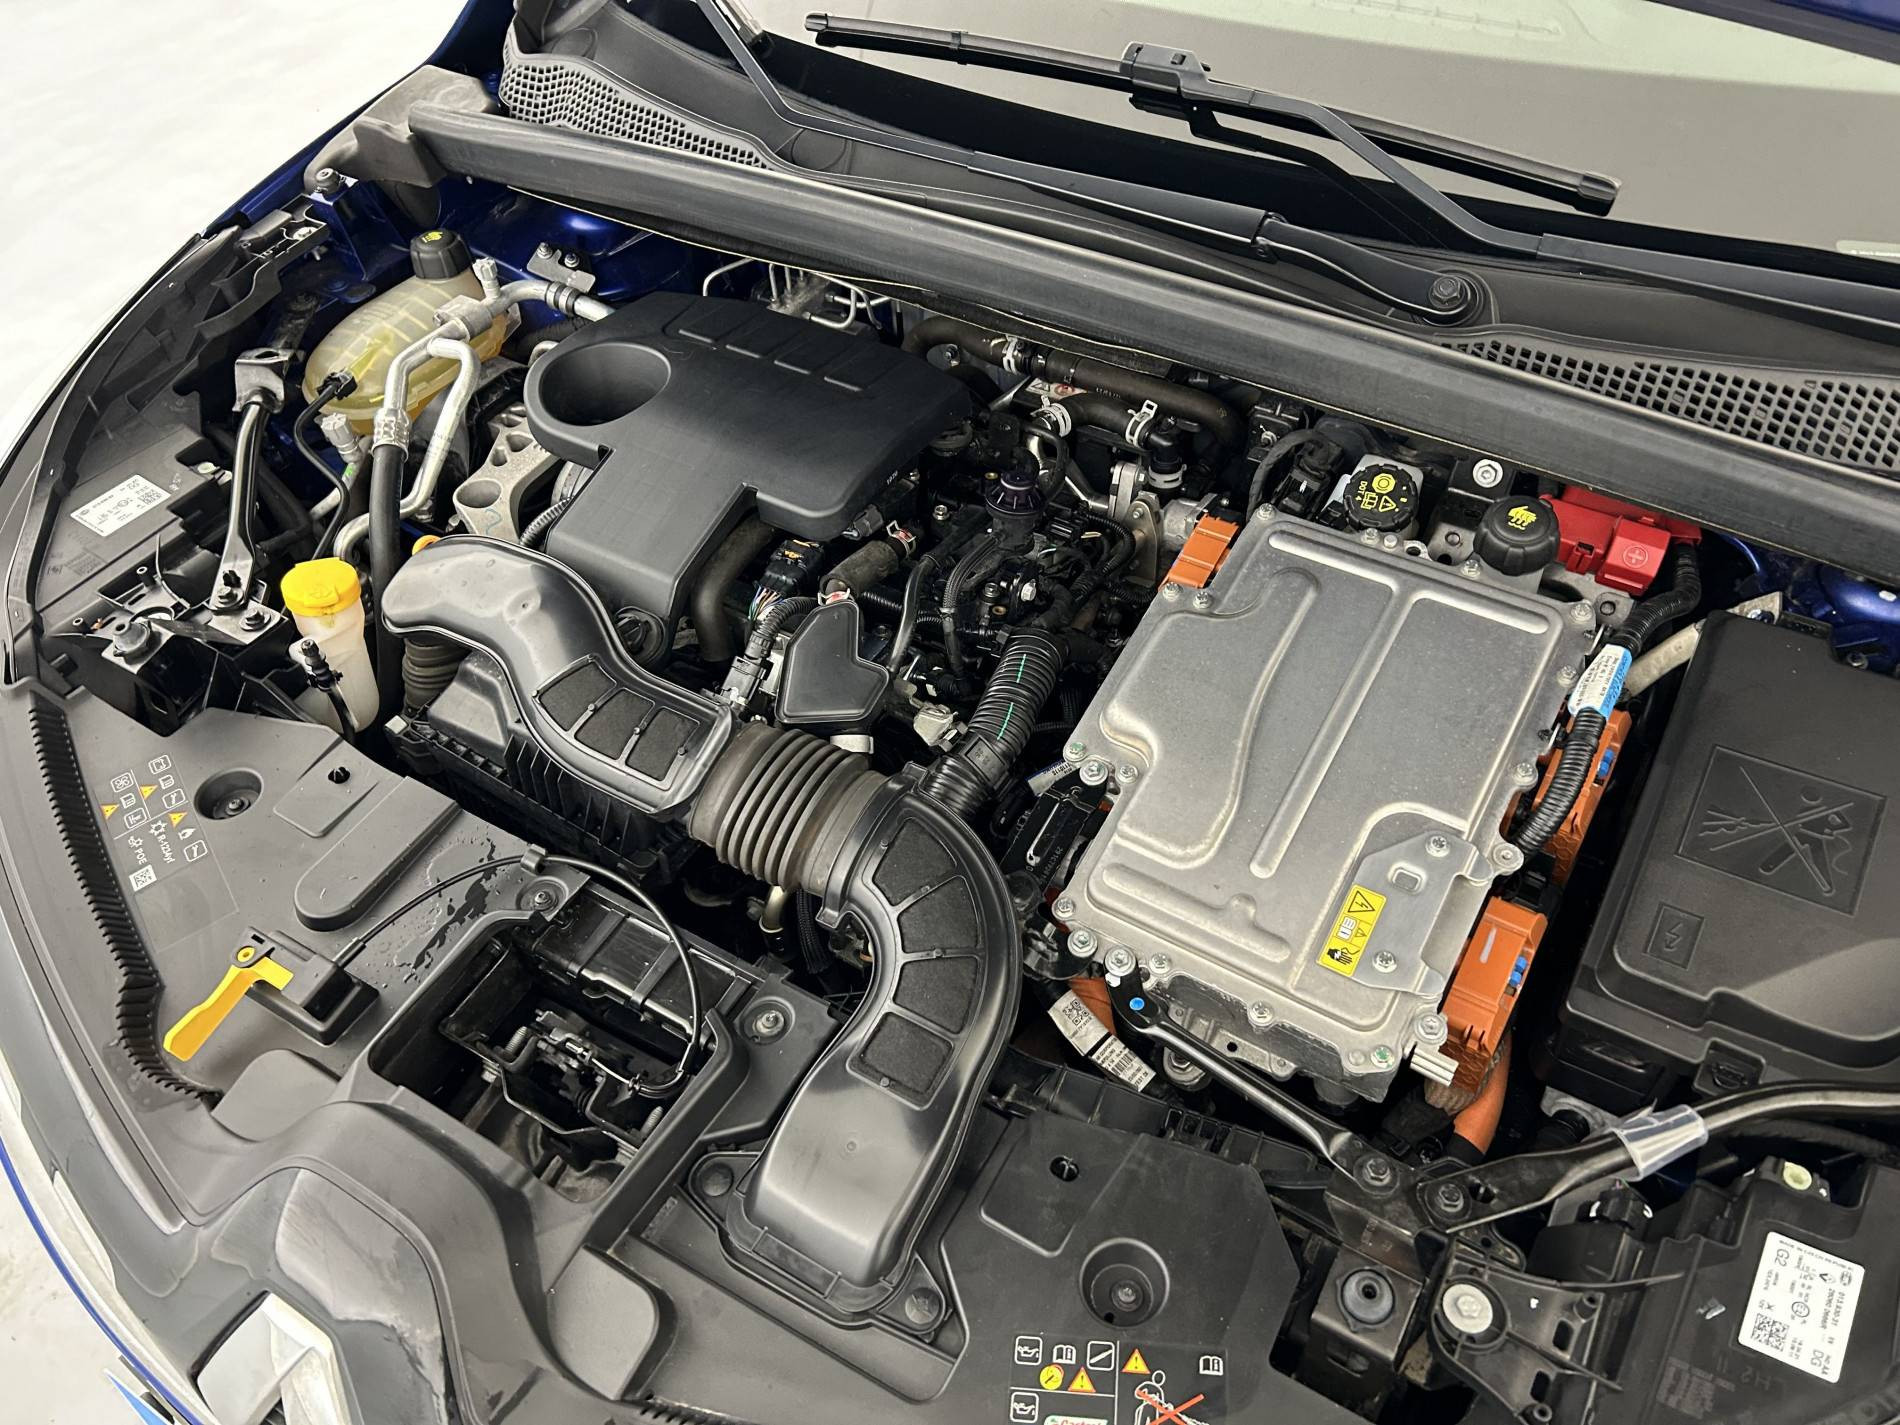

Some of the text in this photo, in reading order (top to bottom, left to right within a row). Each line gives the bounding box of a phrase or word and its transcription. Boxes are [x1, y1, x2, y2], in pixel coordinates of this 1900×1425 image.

[1358, 481, 1368, 495] DOT
[135, 848, 147, 865] POE
[157, 834, 175, 864] R-1234yf
